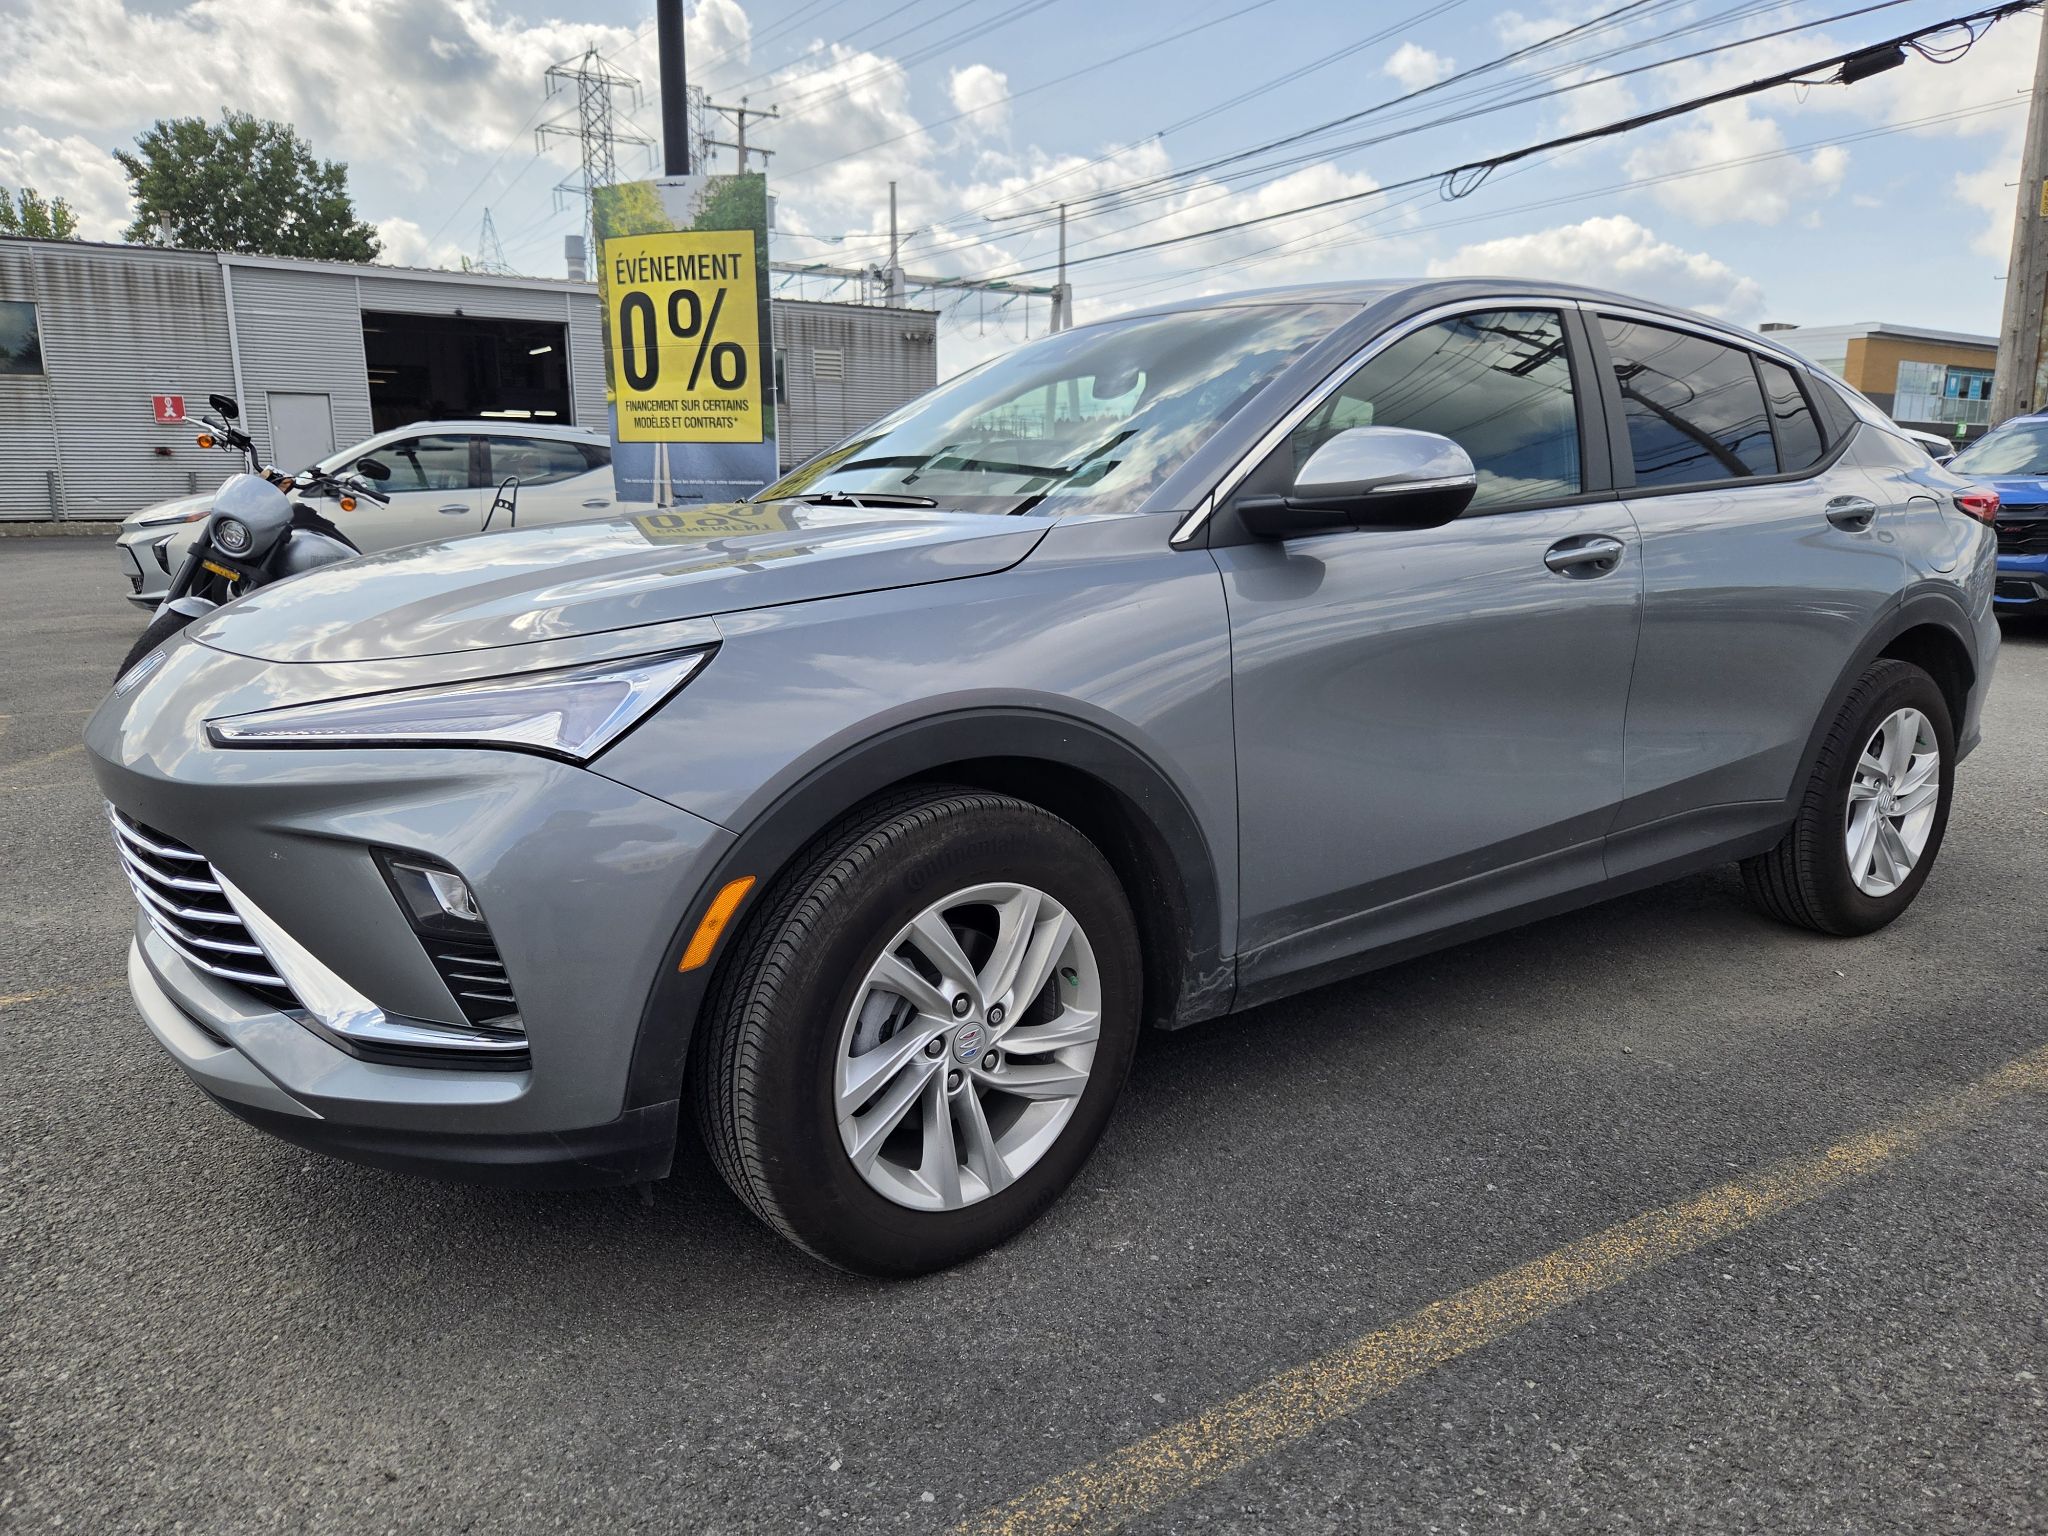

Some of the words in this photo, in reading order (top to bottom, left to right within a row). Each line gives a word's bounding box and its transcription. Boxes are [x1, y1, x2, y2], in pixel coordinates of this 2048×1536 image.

[616, 250, 742, 285] ÉVÉNEMENT
[619, 287, 748, 392] 0%
[625, 399, 679, 412] FINANCEMENT
[681, 399, 700, 412] SUR
[702, 399, 750, 412] CERTAINS
[633, 413, 670, 429] MODÈLES
[672, 416, 682, 429] ET
